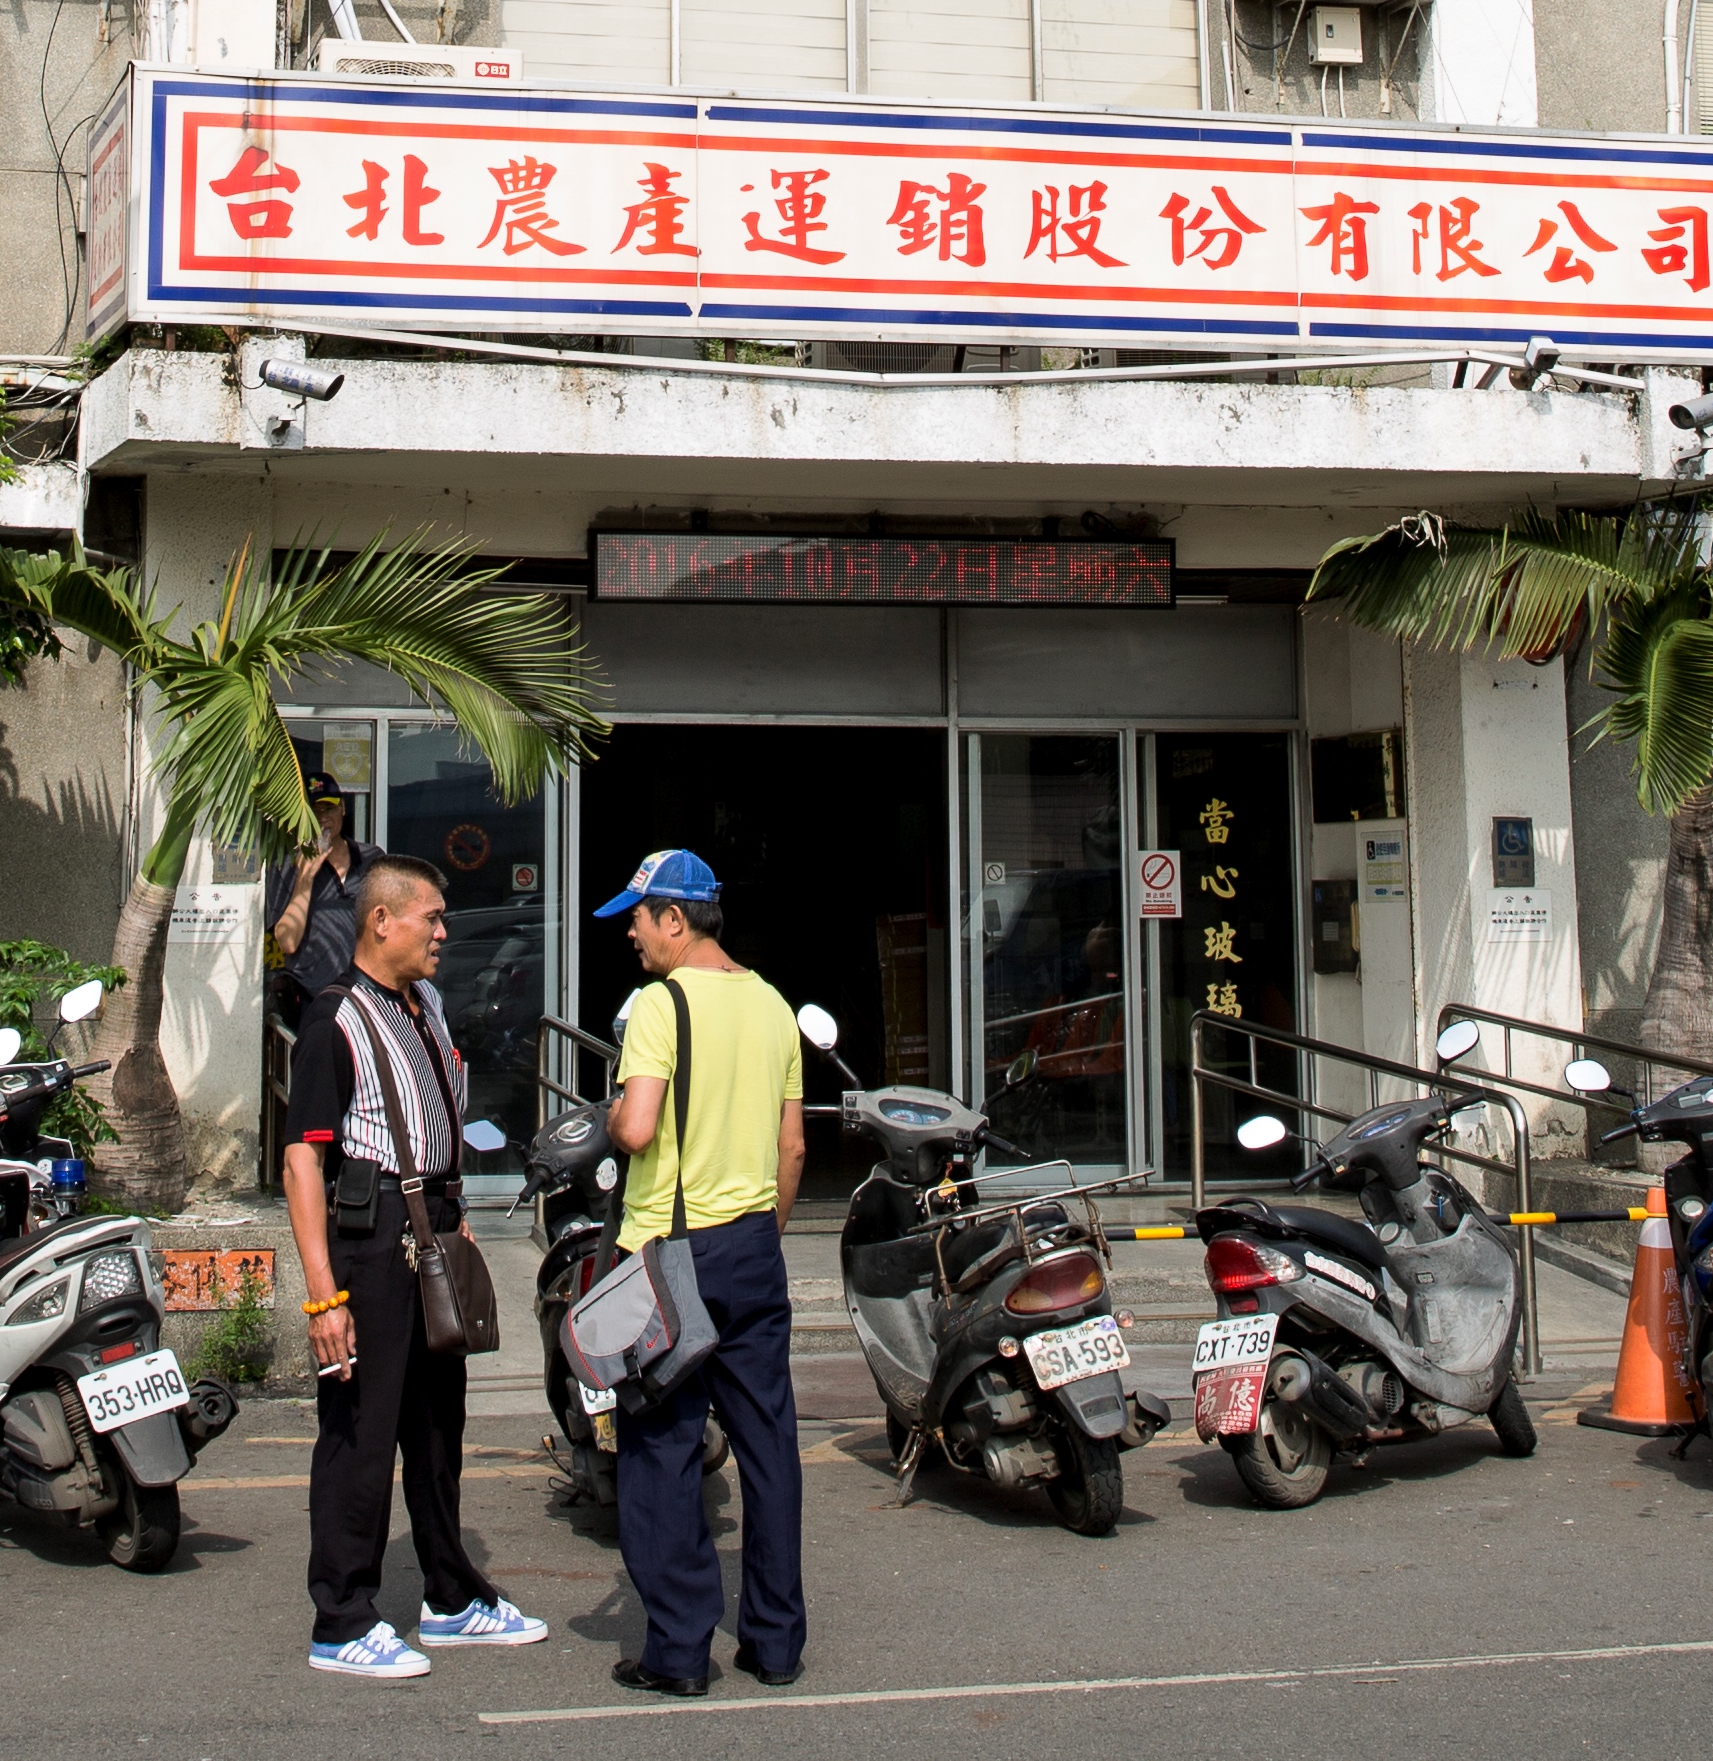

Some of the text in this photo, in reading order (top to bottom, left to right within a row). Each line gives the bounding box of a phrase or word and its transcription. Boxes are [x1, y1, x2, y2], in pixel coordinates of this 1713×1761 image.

[490, 65, 508, 76] 日立
[208, 144, 1713, 295] 台北農產運銷股份有限公司
[1198, 797, 1243, 1020] 當心玻璃
